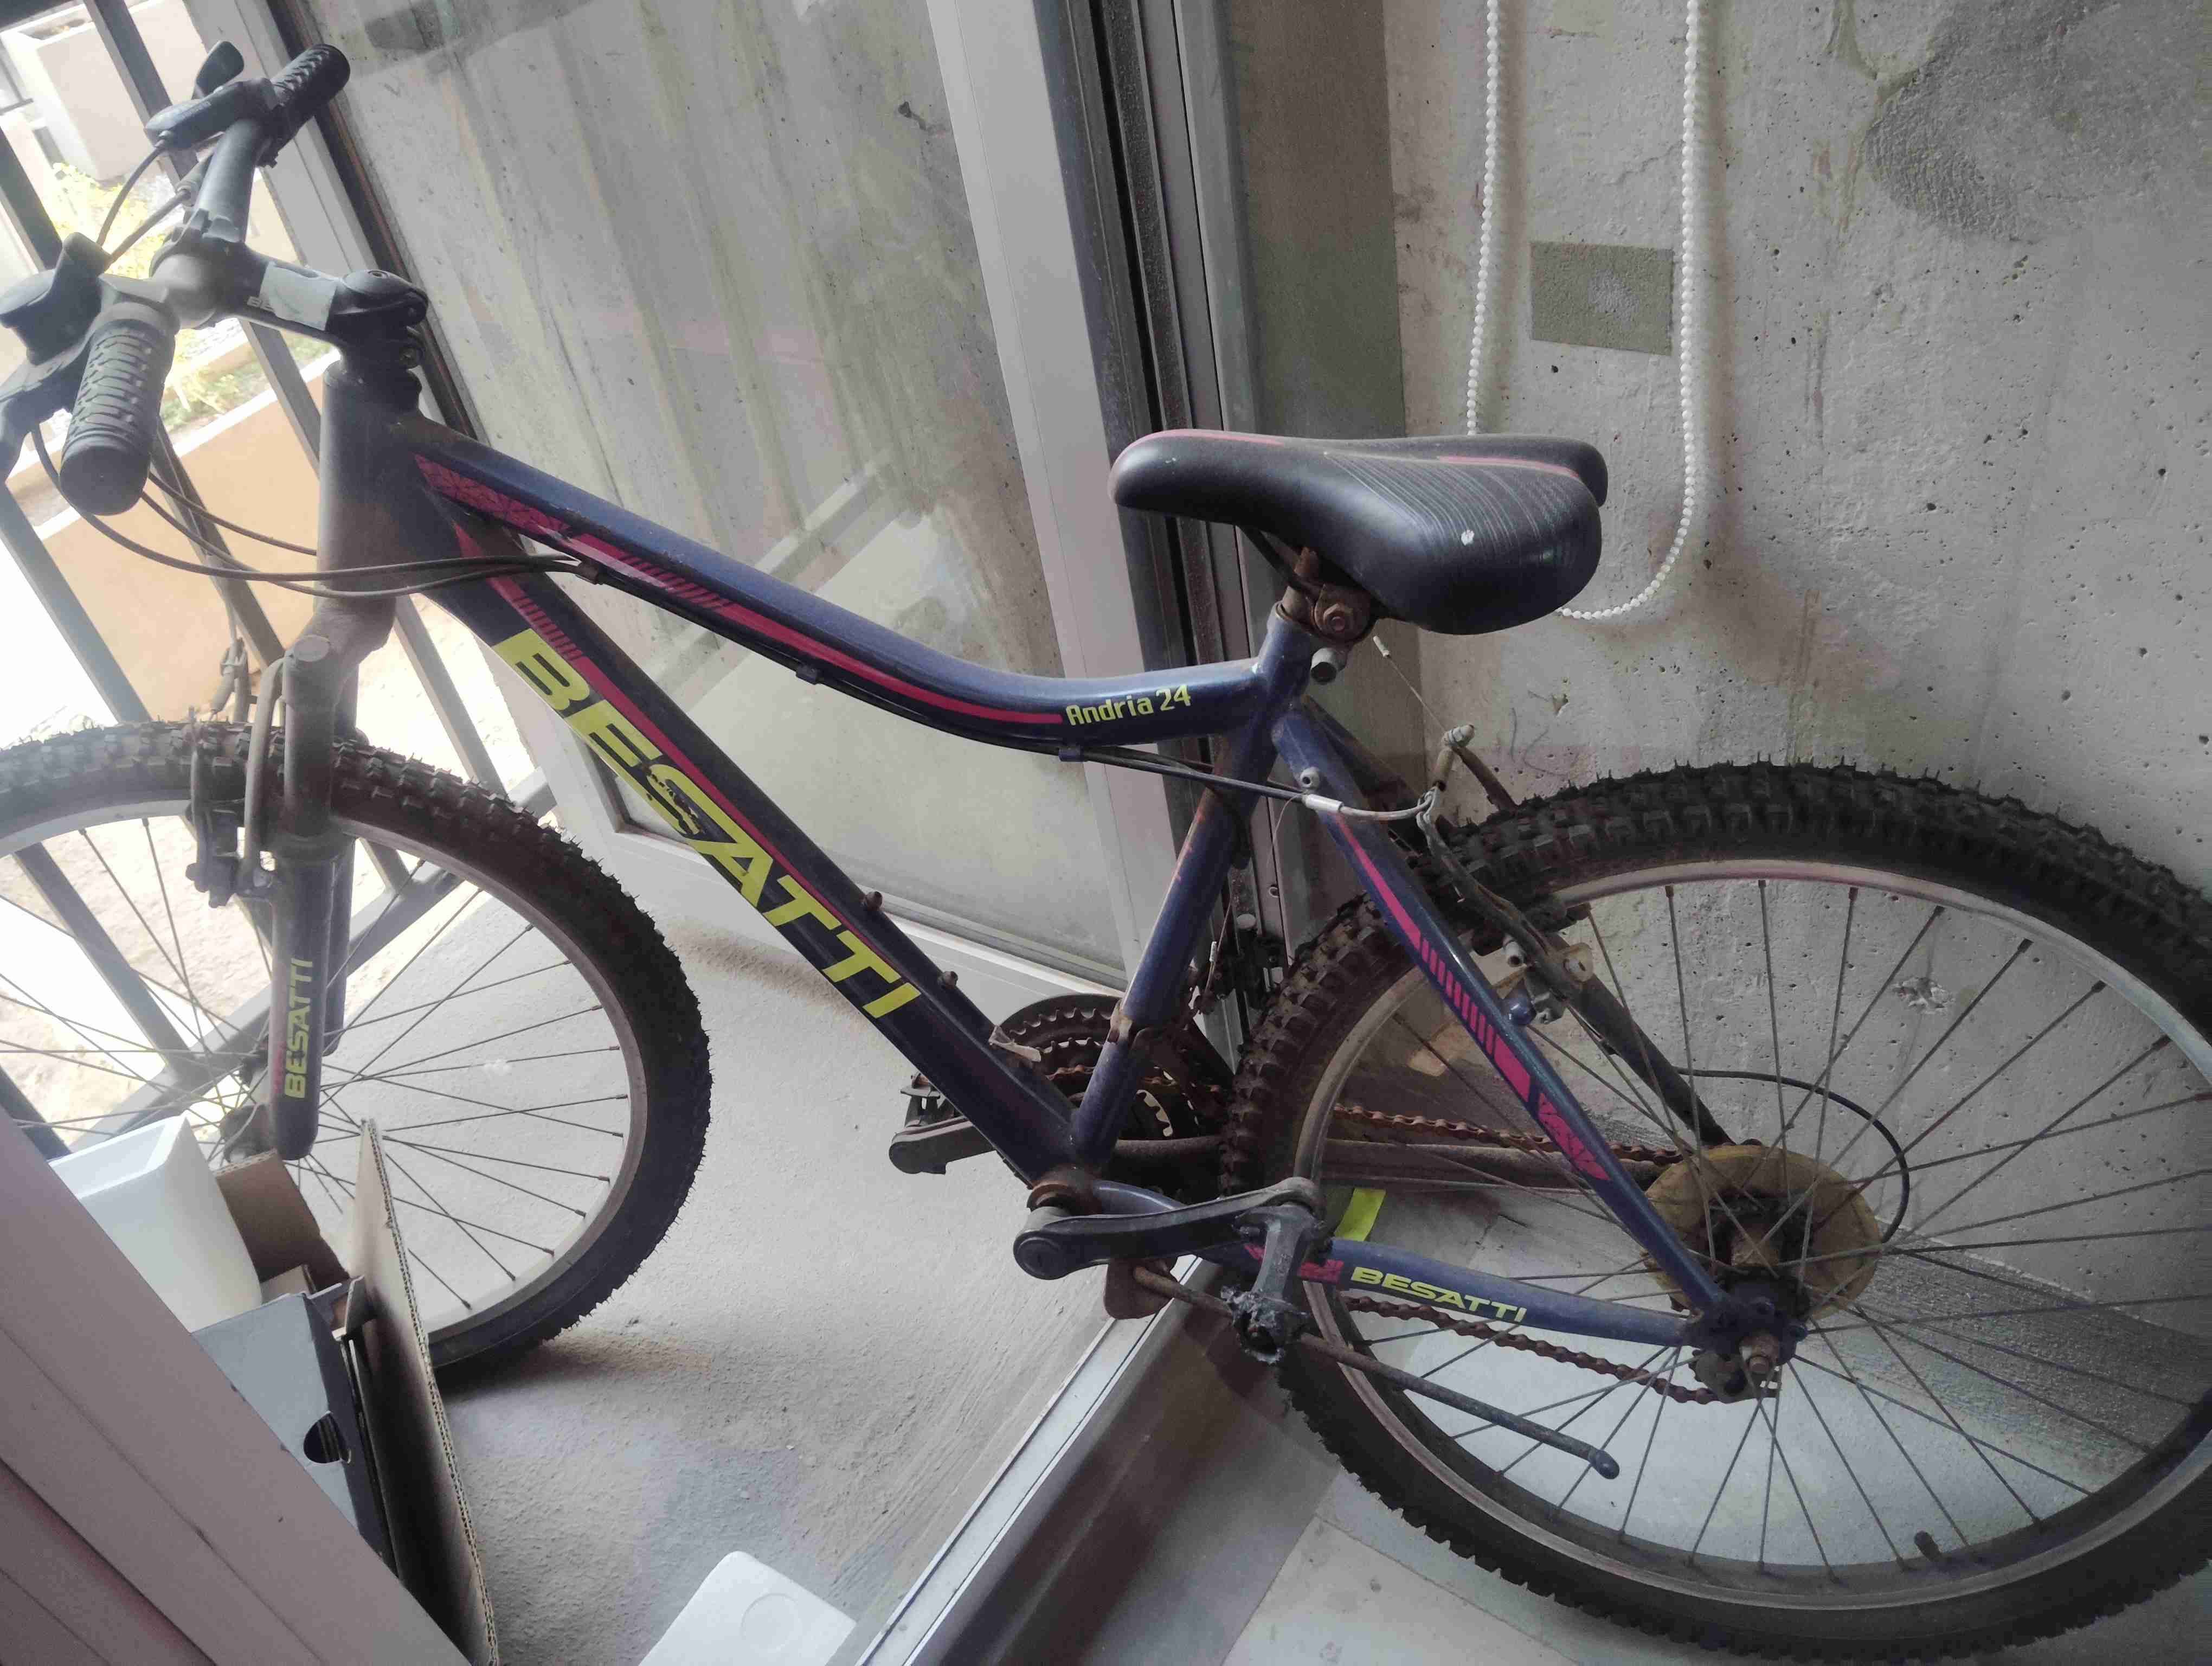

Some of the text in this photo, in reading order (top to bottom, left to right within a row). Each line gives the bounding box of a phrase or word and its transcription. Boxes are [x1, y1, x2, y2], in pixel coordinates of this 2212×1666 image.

[1066, 684, 1192, 726] Andria 24
[491, 628, 921, 1018] BESATTI
[284, 958, 313, 1099] BESATTI
[1351, 1266, 1527, 1322] BESATTI
